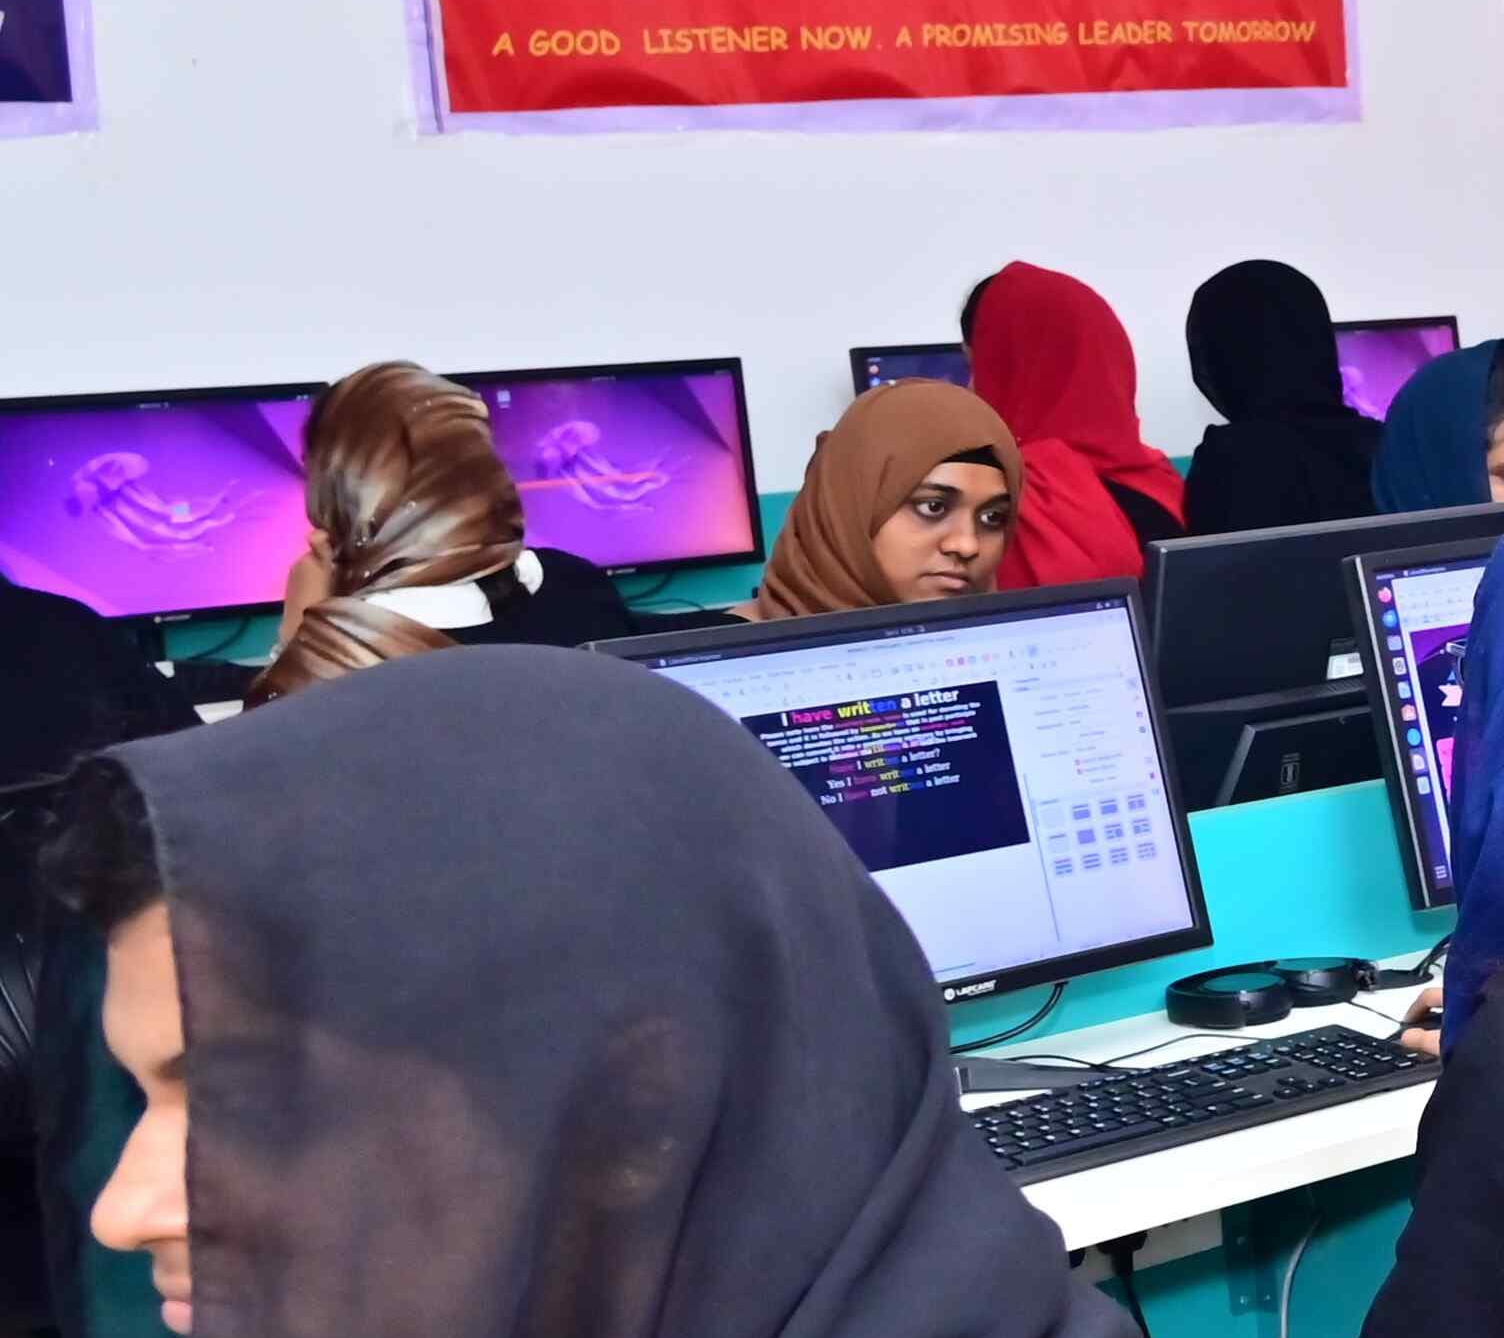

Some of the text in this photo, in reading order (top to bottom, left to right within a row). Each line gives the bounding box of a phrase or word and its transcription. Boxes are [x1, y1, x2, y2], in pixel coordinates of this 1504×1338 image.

[492, 31, 515, 56] A
[528, 30, 621, 56] GOOD
[643, 26, 788, 54] LISTENER
[895, 26, 913, 48] A
[922, 23, 1069, 48] PROMISING
[1079, 20, 1173, 46] LEADER
[1182, 20, 1317, 43] TOMORROW
[781, 712, 788, 727] I
[791, 709, 833, 724] have
[837, 701, 897, 713] written
[901, 697, 912, 709] a
[914, 690, 959, 706] letter
